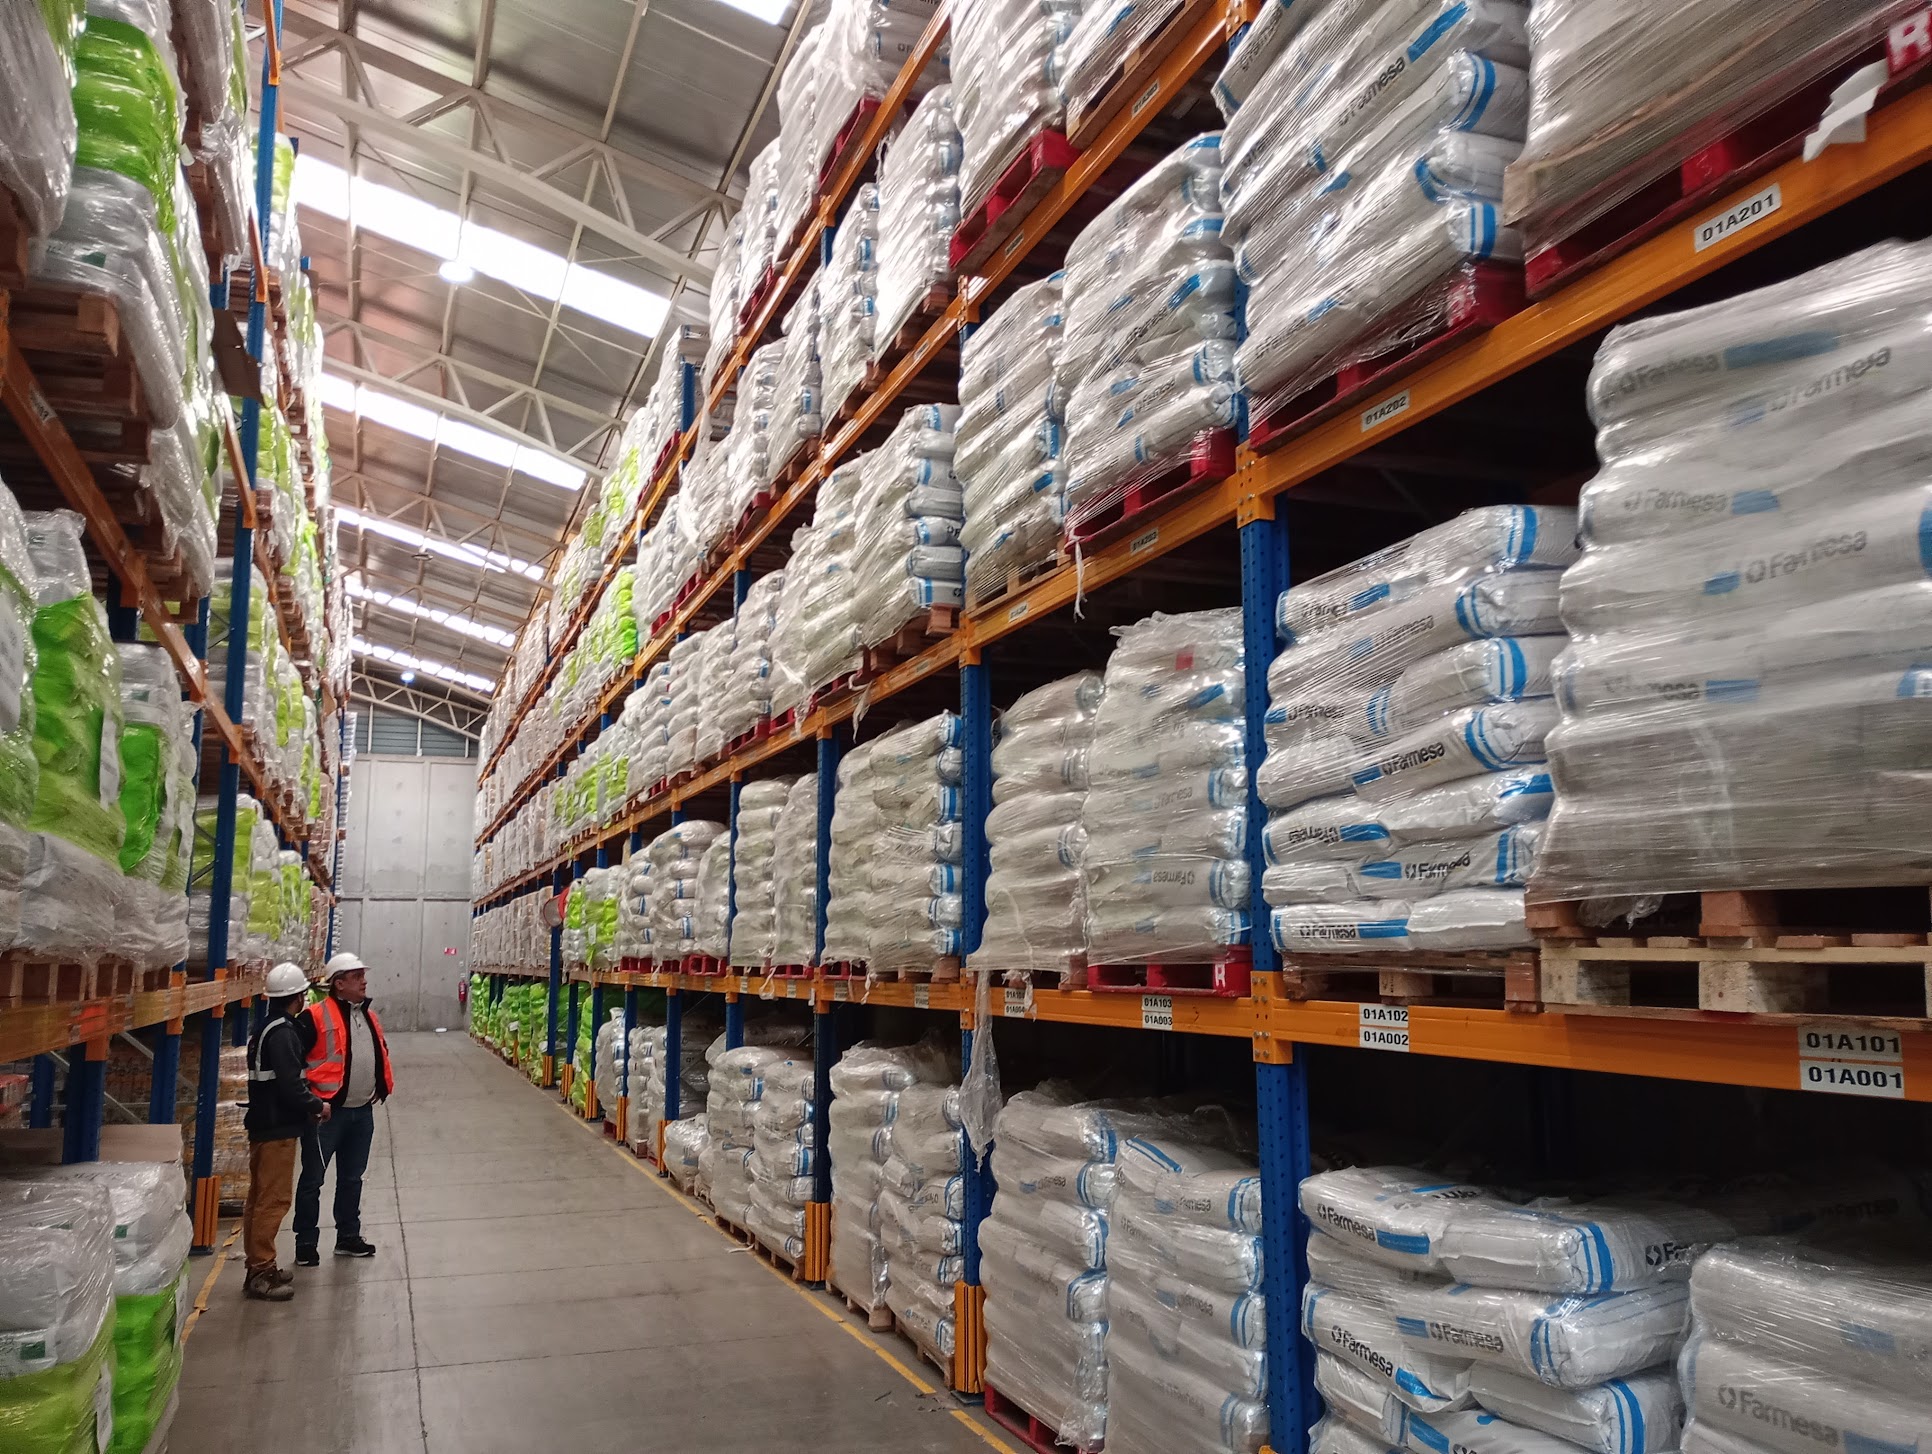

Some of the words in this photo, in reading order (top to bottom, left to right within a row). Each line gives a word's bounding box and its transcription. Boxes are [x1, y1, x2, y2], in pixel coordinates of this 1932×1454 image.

[1702, 194, 1775, 242] 01A201
[1366, 396, 1407, 425] 01A202
[1391, 742, 1445, 772] Farmesa
[1312, 924, 1357, 939] Farmesa
[1144, 997, 1173, 1008] 01A103
[1363, 1008, 1409, 1022] 01A102
[1144, 1015, 1173, 1026] 01A003
[1364, 1030, 1409, 1046] 01A002
[1806, 1032, 1900, 1053] 01A101
[1808, 1066, 1903, 1089] 01A001
[1327, 1207, 1376, 1242] Farmesa
[1443, 1323, 1504, 1351] Farmesa
[1342, 1329, 1394, 1378] Farmesa
[1739, 1392, 1839, 1446] Farmesa
